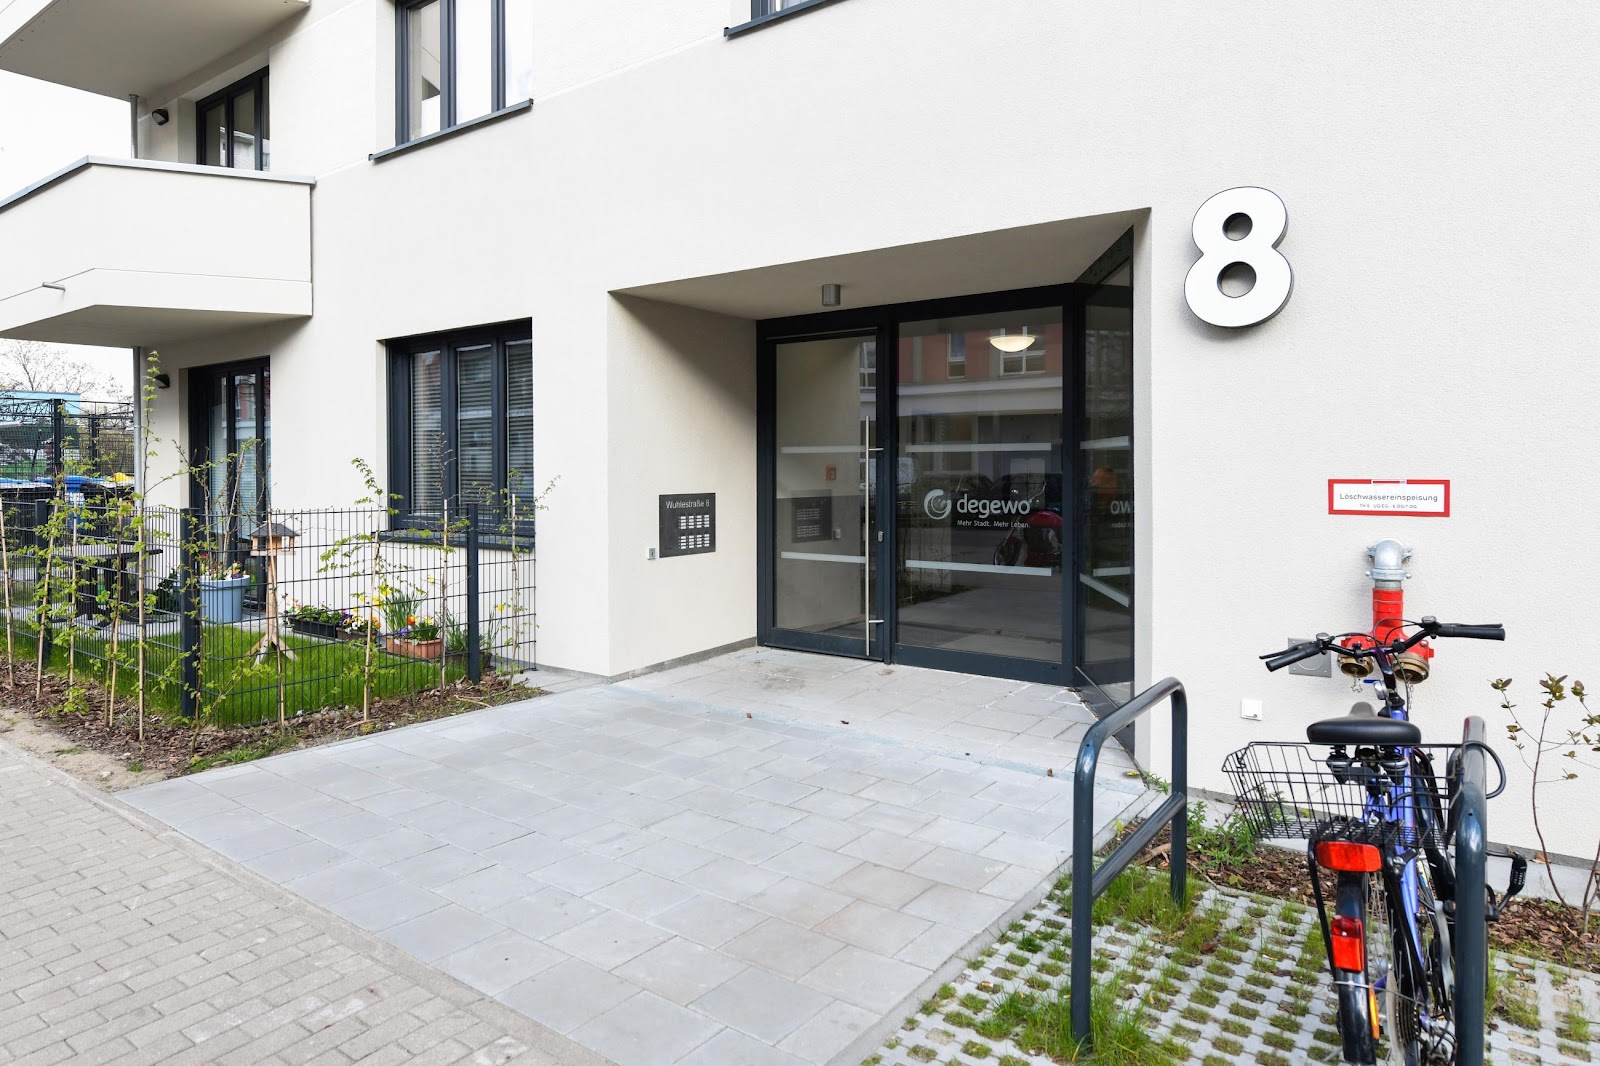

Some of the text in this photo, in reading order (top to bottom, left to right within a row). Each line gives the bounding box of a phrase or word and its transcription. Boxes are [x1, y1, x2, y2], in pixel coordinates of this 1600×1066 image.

[1184, 186, 1294, 328] 8
[665, 498, 710, 509] Wuhlestraße 8
[1339, 493, 1438, 503] Löschwassereinspeisung
[956, 493, 1031, 519] degewo
[993, 520, 1009, 528] Mehr
